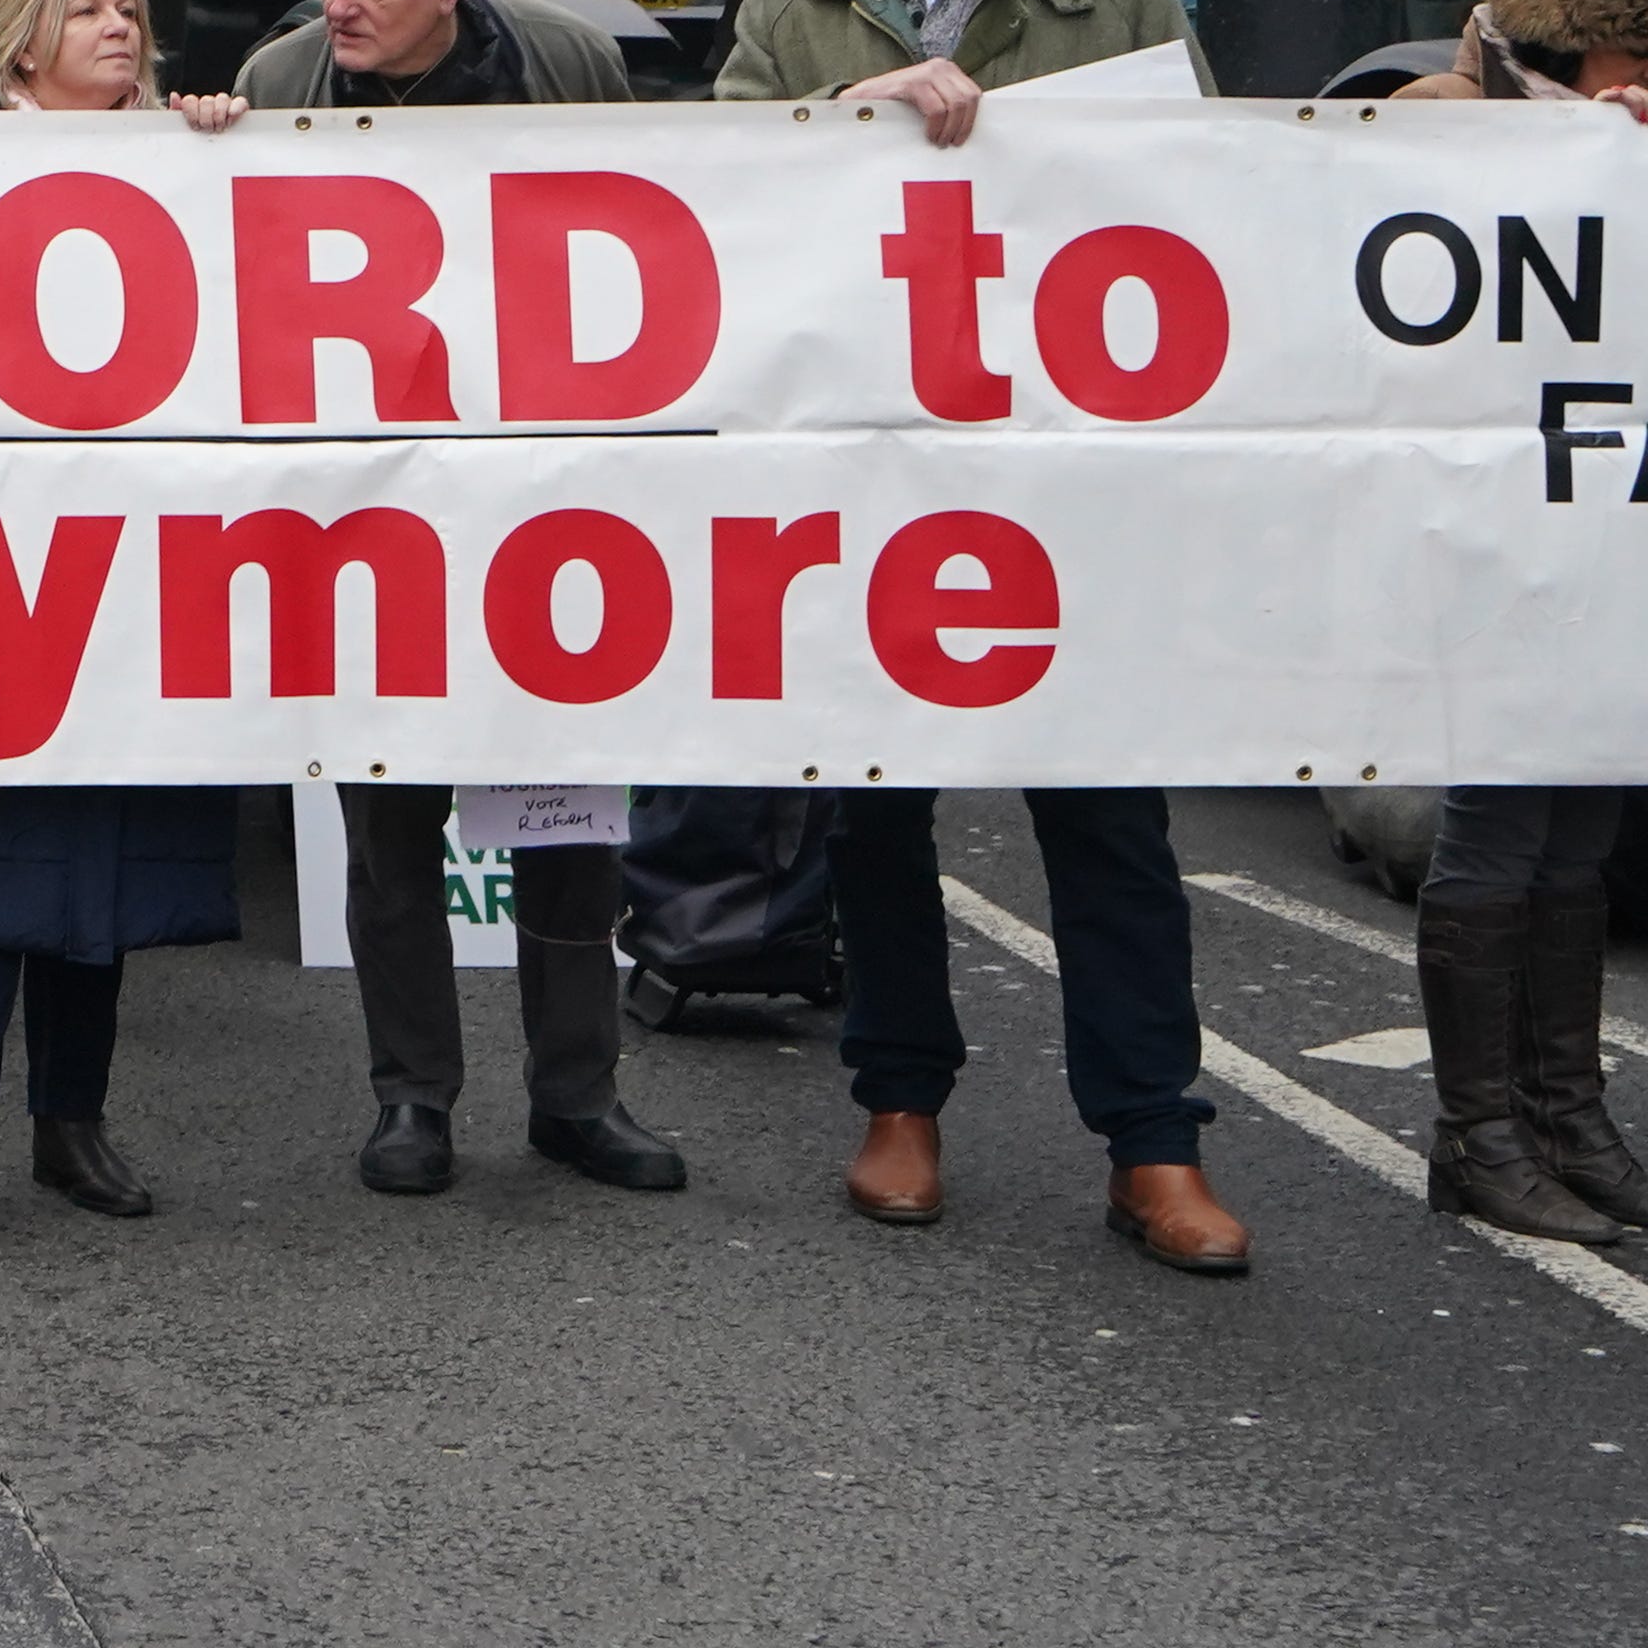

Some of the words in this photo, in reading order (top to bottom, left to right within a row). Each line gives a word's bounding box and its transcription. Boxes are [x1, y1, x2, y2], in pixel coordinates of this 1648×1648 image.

[881, 181, 1229, 422] to
[1355, 212, 1604, 346] ON
[1539, 382, 1648, 503] F
